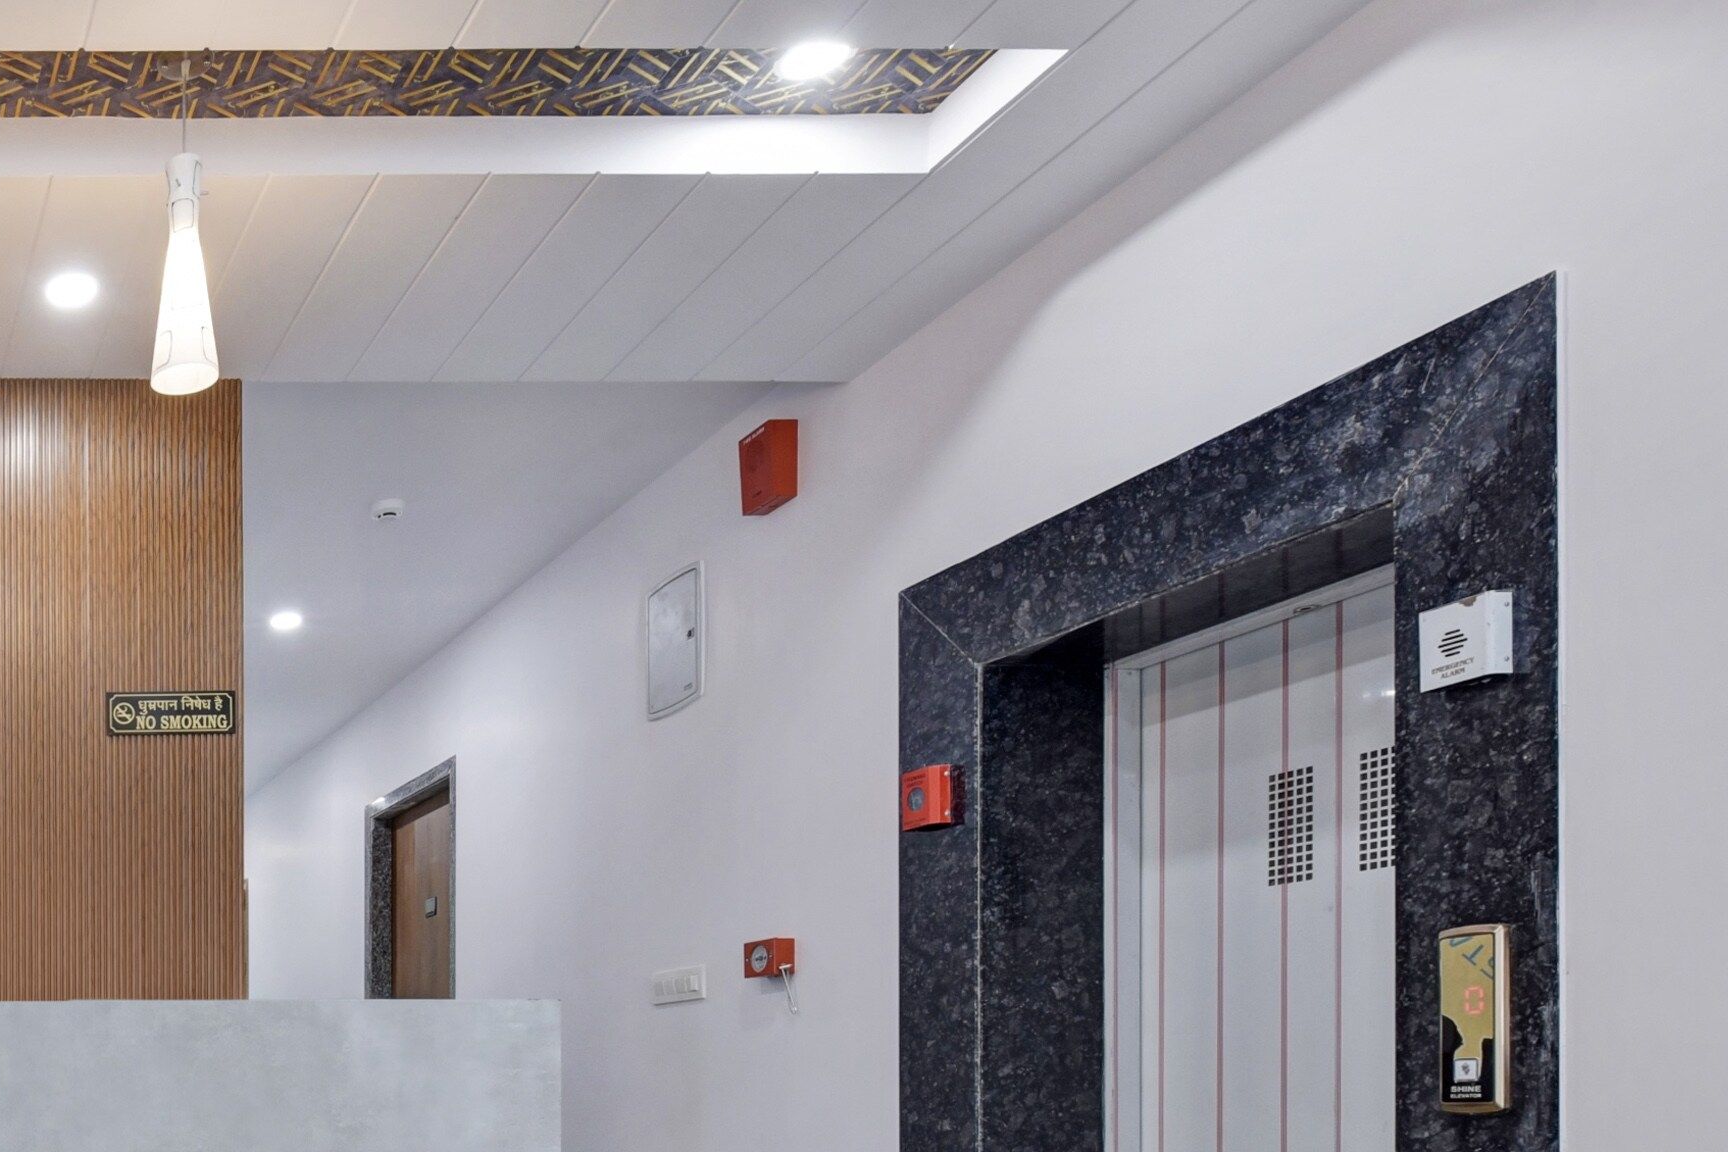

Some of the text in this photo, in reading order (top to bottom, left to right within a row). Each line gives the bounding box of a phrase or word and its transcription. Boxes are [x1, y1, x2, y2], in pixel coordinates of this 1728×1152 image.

[1431, 657, 1475, 675] EMERGENCY
[1441, 667, 1465, 679] ALARM
[136, 714, 228, 730] NO SMOKING
[1450, 1085, 1482, 1093] SHINE
